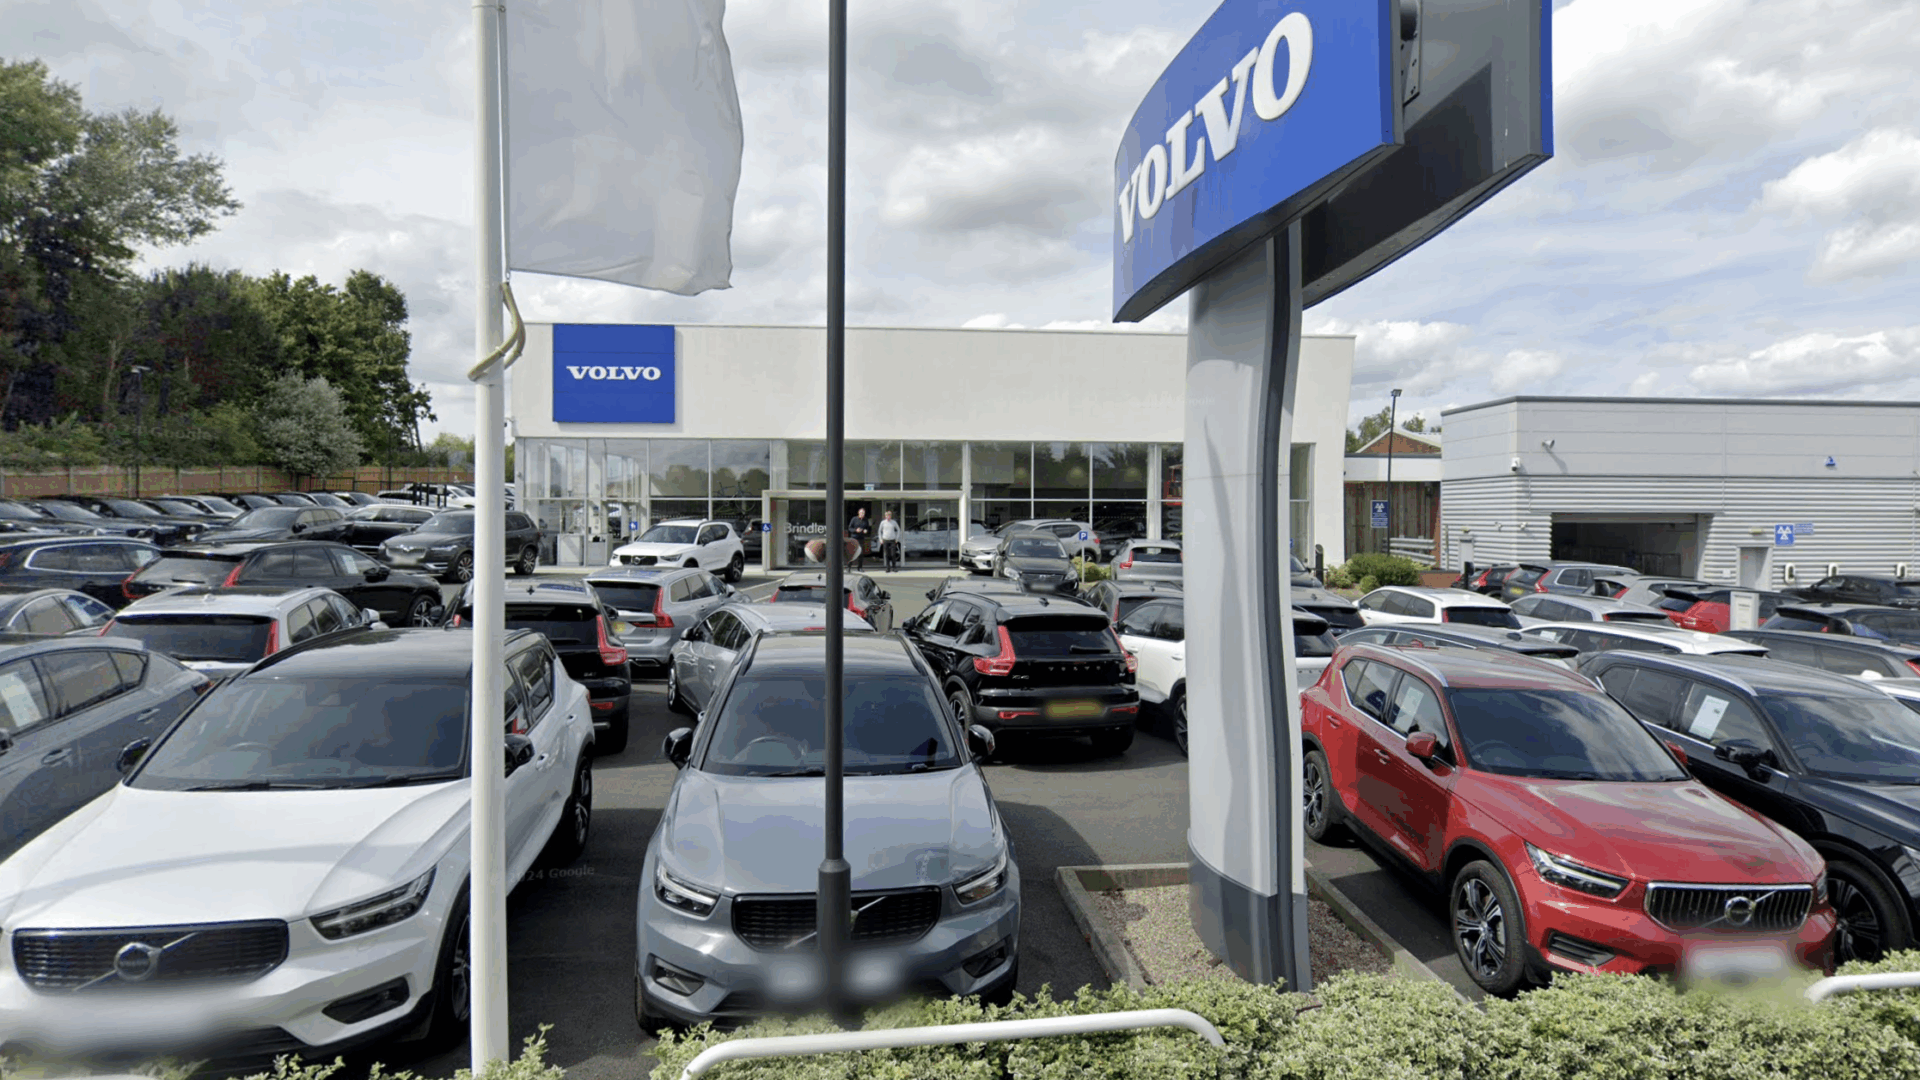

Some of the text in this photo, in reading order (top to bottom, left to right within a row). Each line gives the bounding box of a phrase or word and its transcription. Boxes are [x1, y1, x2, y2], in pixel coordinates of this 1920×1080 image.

[1118, 11, 1313, 244] VOLVO
[566, 365, 661, 381] VOLVO
[1080, 532, 1087, 540] P
